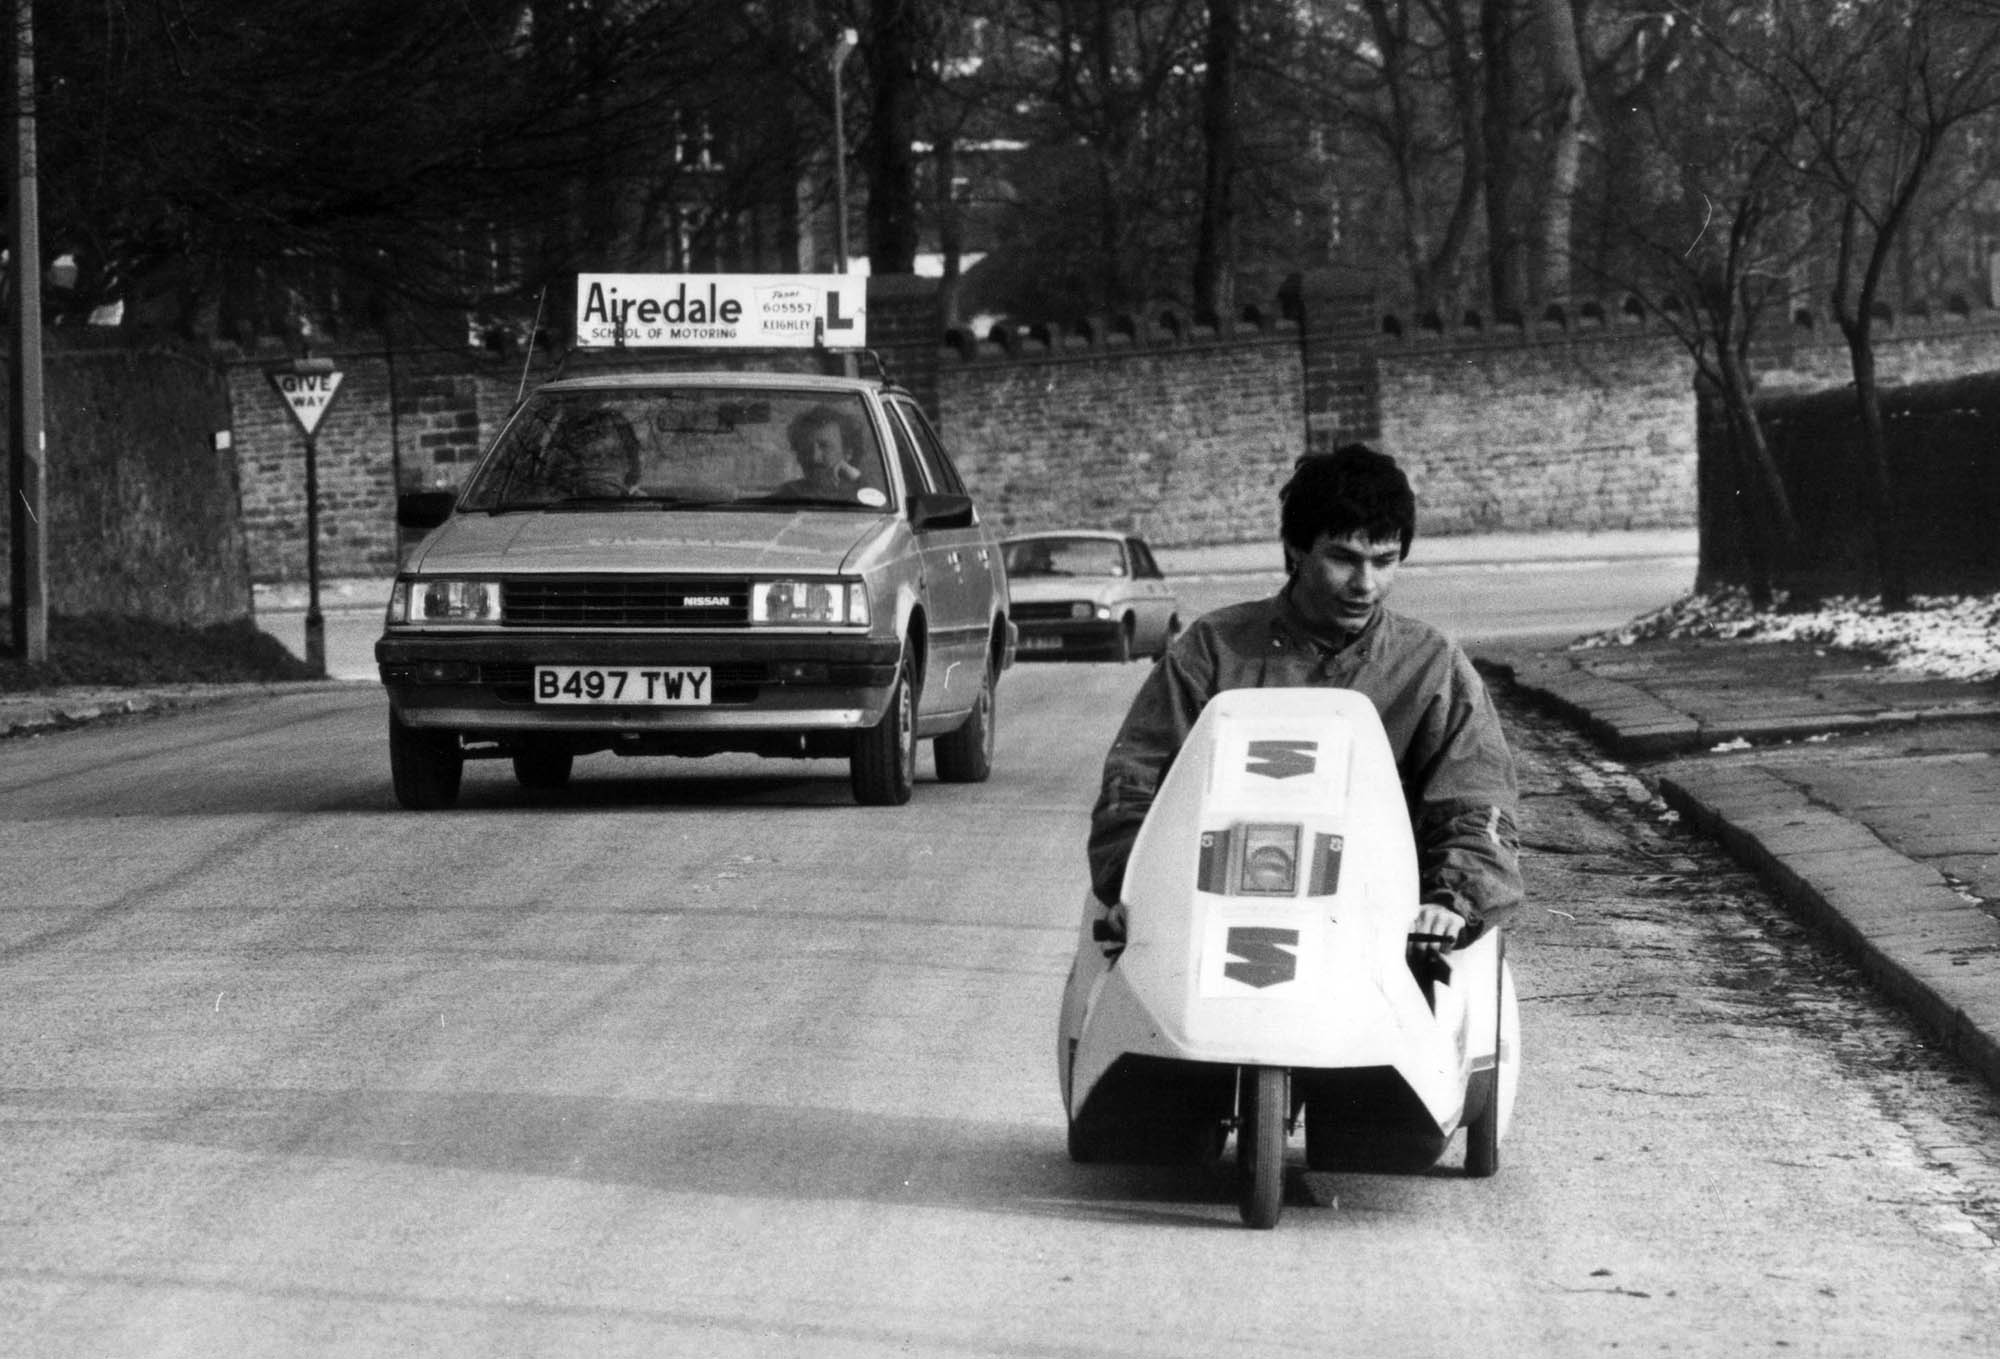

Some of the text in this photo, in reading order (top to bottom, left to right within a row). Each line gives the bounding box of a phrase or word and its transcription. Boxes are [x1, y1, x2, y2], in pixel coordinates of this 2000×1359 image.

[583, 281, 743, 324] Airedale
[827, 291, 853, 329] L
[763, 319, 811, 330] KEIGHLEY
[592, 328, 738, 339] SCHOL OF MOTORING
[282, 375, 332, 391] GIVE
[293, 396, 325, 407] WAY
[683, 596, 730, 606] NISSAN
[538, 670, 708, 699] B497 TWY
